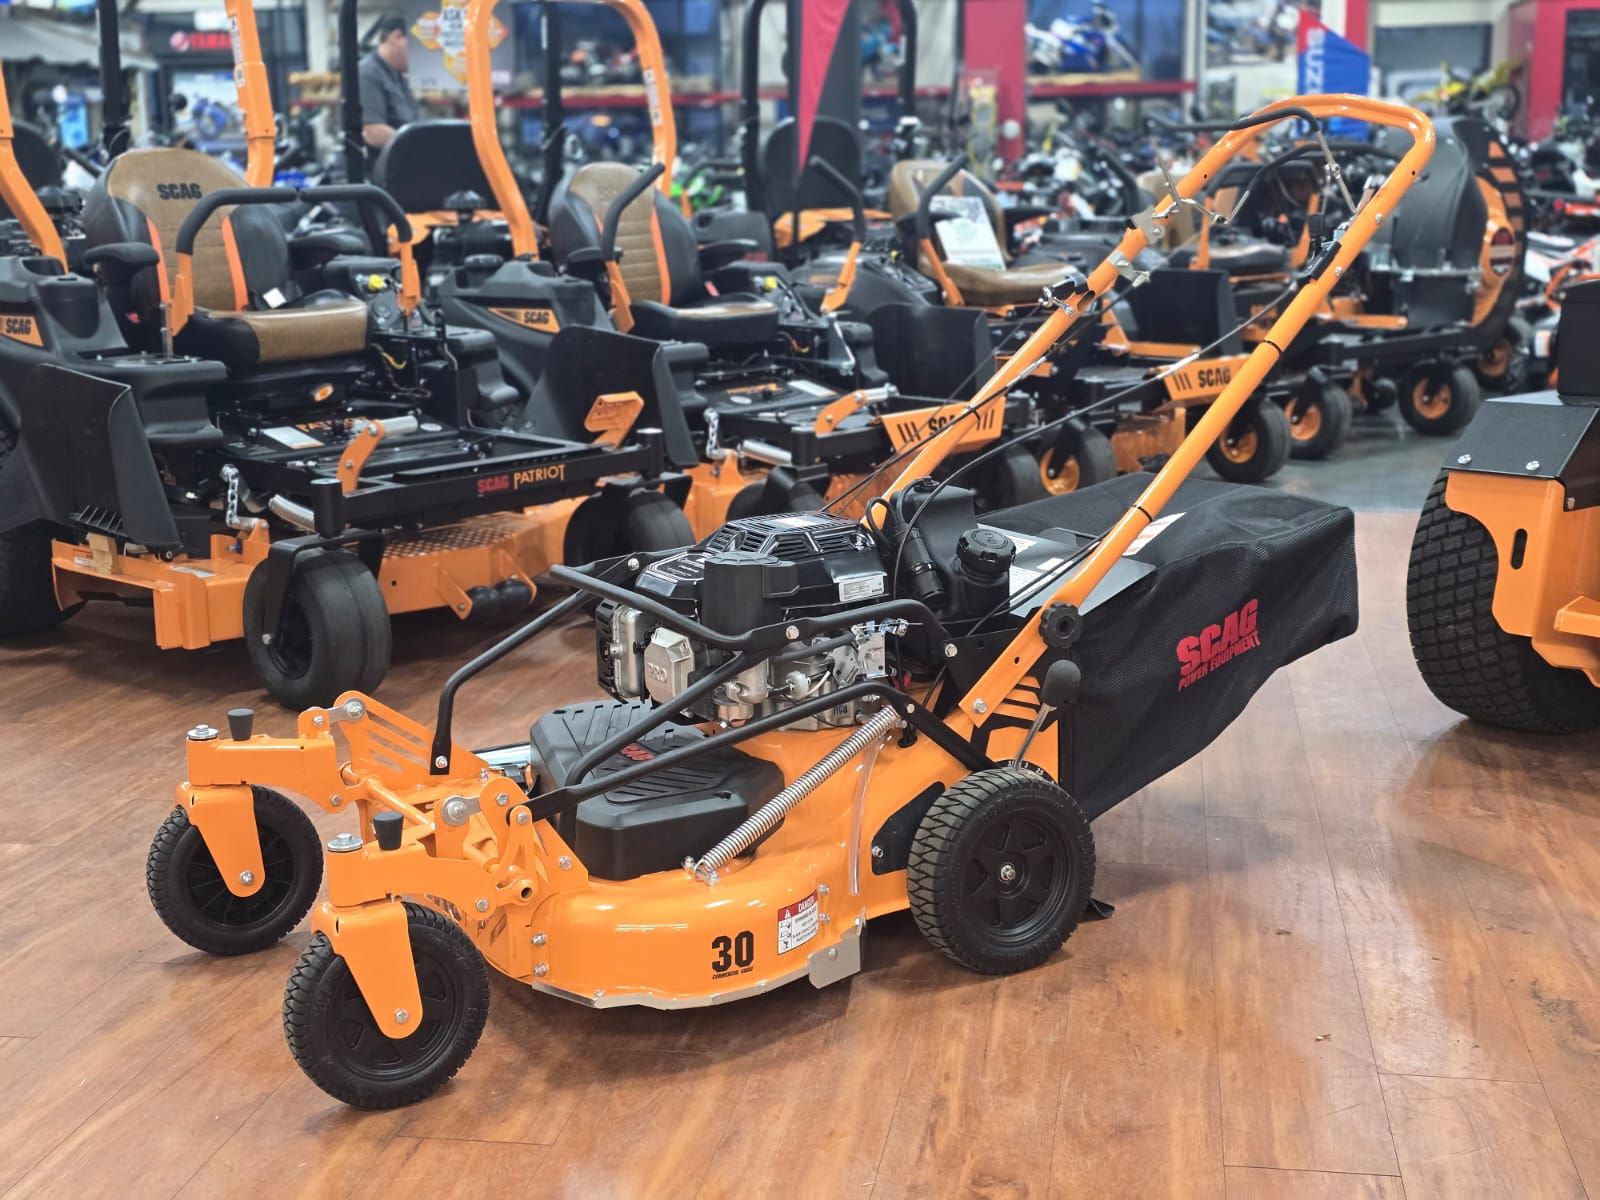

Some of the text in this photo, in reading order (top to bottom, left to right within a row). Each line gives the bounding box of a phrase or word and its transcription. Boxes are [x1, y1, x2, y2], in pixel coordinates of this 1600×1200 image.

[157, 183, 202, 200] SCAG
[6, 318, 31, 335] SCAG
[524, 311, 550, 324] SCAG
[1198, 367, 1231, 388] SCAG
[928, 414, 956, 436] SC
[477, 464, 565, 493] SCAG PATRIOT
[1176, 598, 1259, 676] SCAG
[1178, 630, 1261, 692] POWER EQUIPMENT
[711, 930, 754, 973] 30
